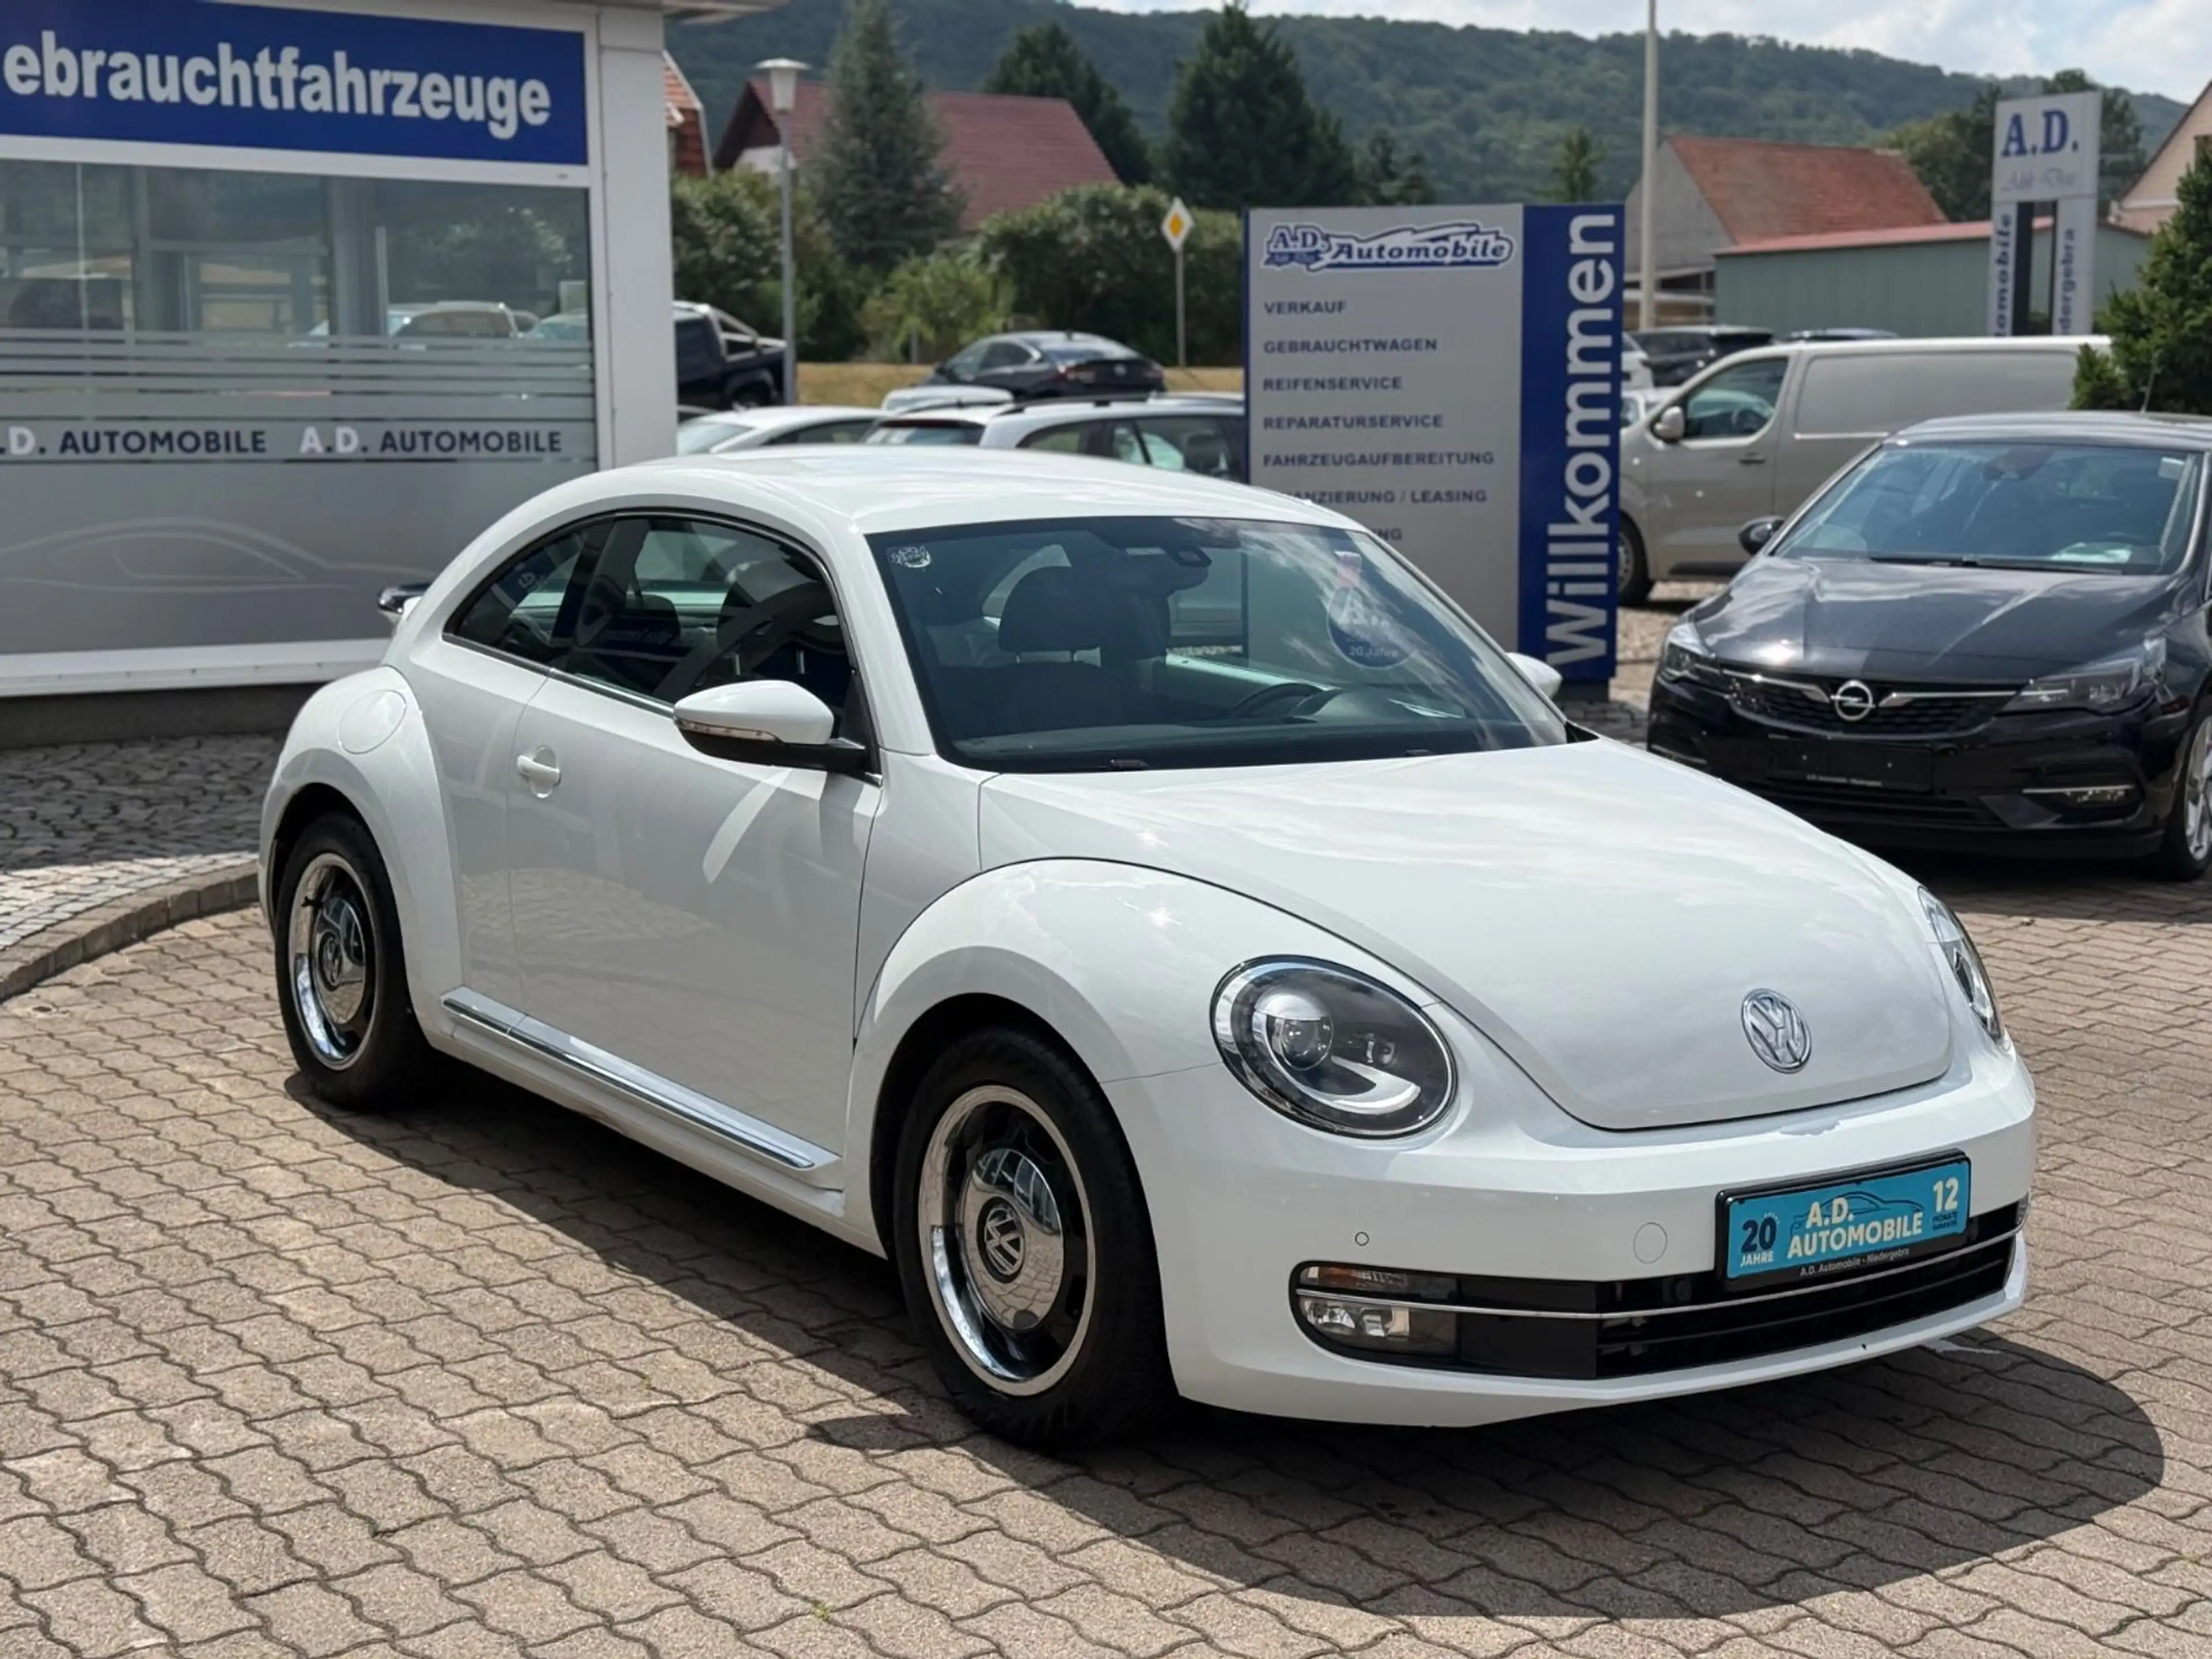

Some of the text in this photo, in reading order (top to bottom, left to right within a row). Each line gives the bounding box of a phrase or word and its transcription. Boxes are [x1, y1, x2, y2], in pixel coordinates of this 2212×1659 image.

[3, 30, 551, 140] ebrauchtfahrzeuge
[2001, 108, 2079, 158] A.D.
[1332, 234, 1506, 262] Automobile
[1263, 301, 1347, 315] VERKAUF
[1263, 338, 1438, 354] GEBRAUCHTWAGEN
[1263, 376, 1403, 391] REIFENSERVICE
[1263, 414, 1444, 429] REPARATURSERVICE
[59, 430, 267, 454] AUTOMOBILE
[299, 426, 562, 454] A.D. AUTOMOBILE
[1545, 214, 1616, 666] Willkommen
[1263, 452, 1495, 467] FAHRZEUGAUFBEREITUNG
[1410, 490, 1487, 503] LEASING
[1933, 1177, 1959, 1213] 12
[1805, 1196, 1854, 1229] A.D.
[1741, 1217, 1777, 1253] 20
[1787, 1211, 1923, 1259] AUTOMOBILE
[1740, 1251, 1775, 1268] JAHRE
